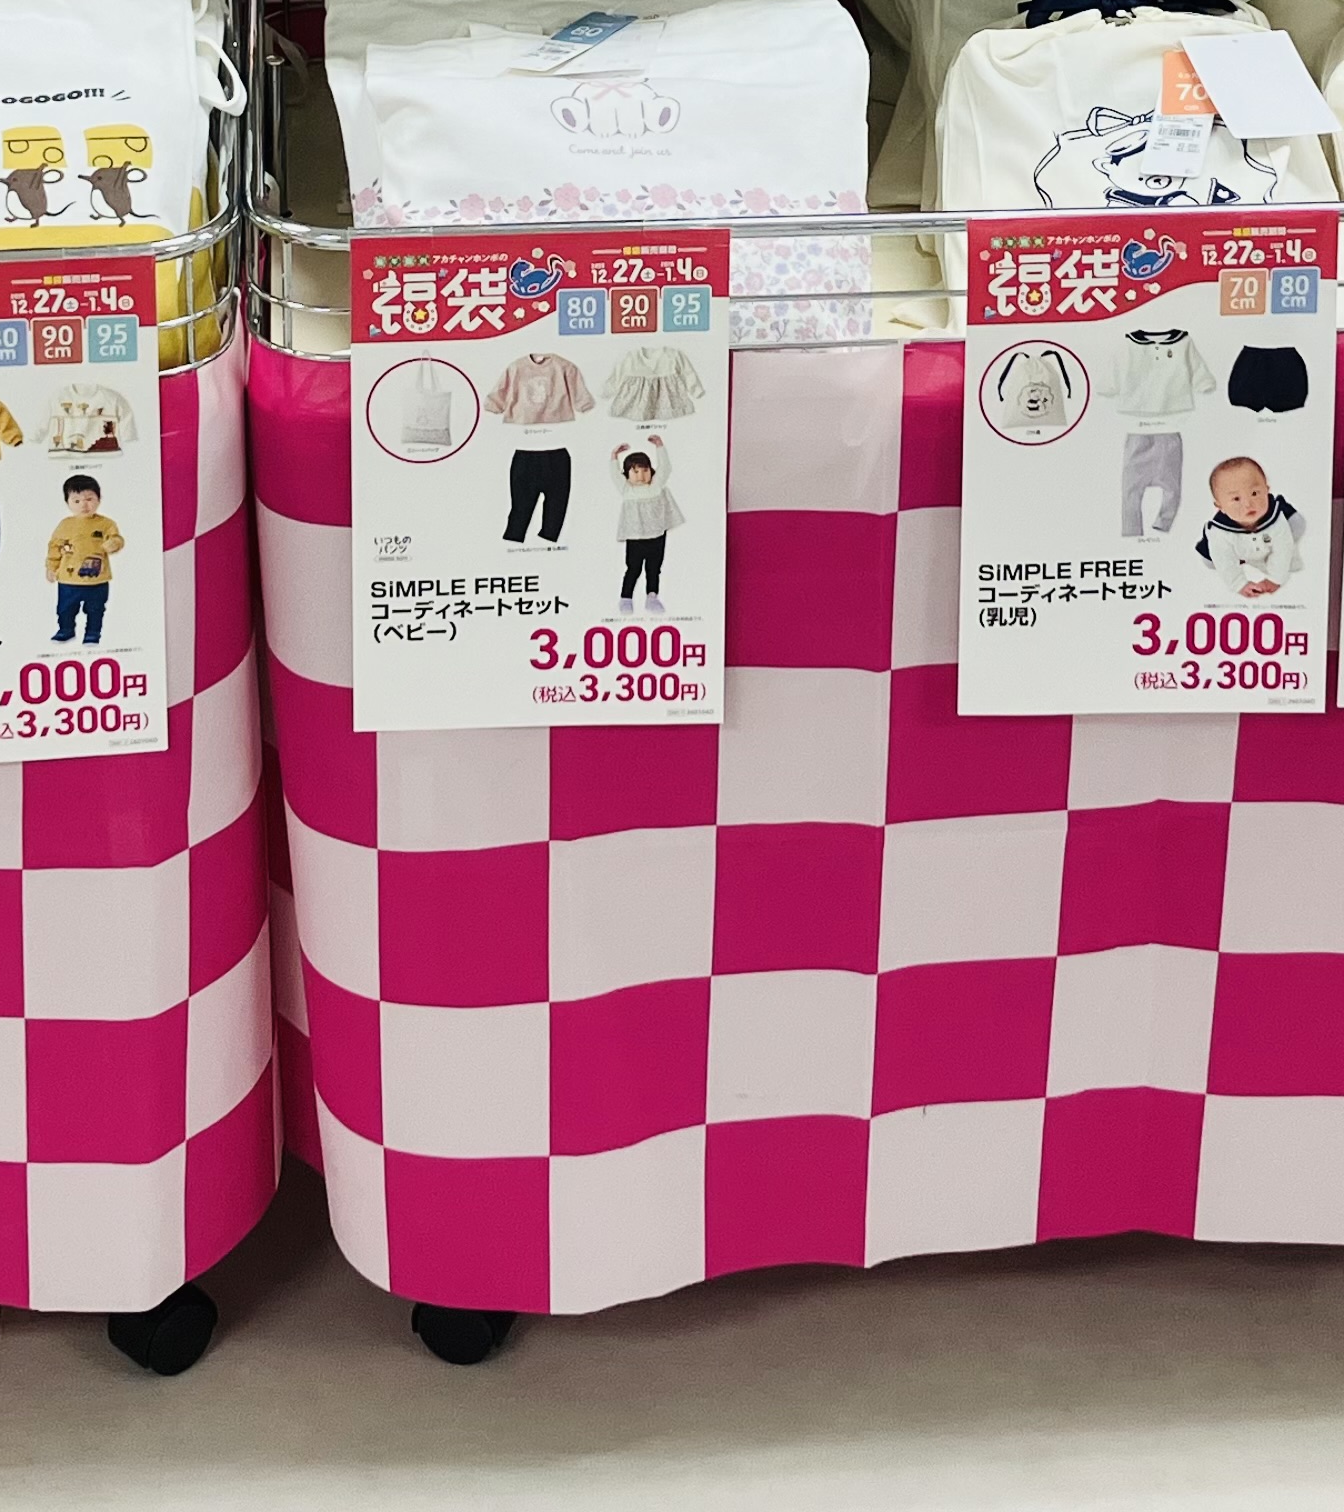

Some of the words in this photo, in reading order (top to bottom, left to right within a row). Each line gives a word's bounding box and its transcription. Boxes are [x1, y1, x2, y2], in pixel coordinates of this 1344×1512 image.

[1175, 83, 1206, 101] 70
[988, 249, 1121, 317] 福袋
[1229, 277, 1259, 298] 70
[1279, 276, 1310, 296] 80
[372, 266, 507, 335] 福袋
[567, 297, 597, 318] 80
[619, 295, 650, 316] 90
[671, 293, 701, 313] 95
[1080, 559, 1144, 577] FREE
[474, 576, 540, 594] FREE
[978, 580, 1173, 603] コーディネートセット
[372, 597, 570, 620] コーディネートセット
[979, 607, 1038, 628] (乳児)
[373, 621, 458, 643] (ベビー)
[1132, 612, 1308, 656] 3,000円
[529, 625, 706, 670] 3,000円
